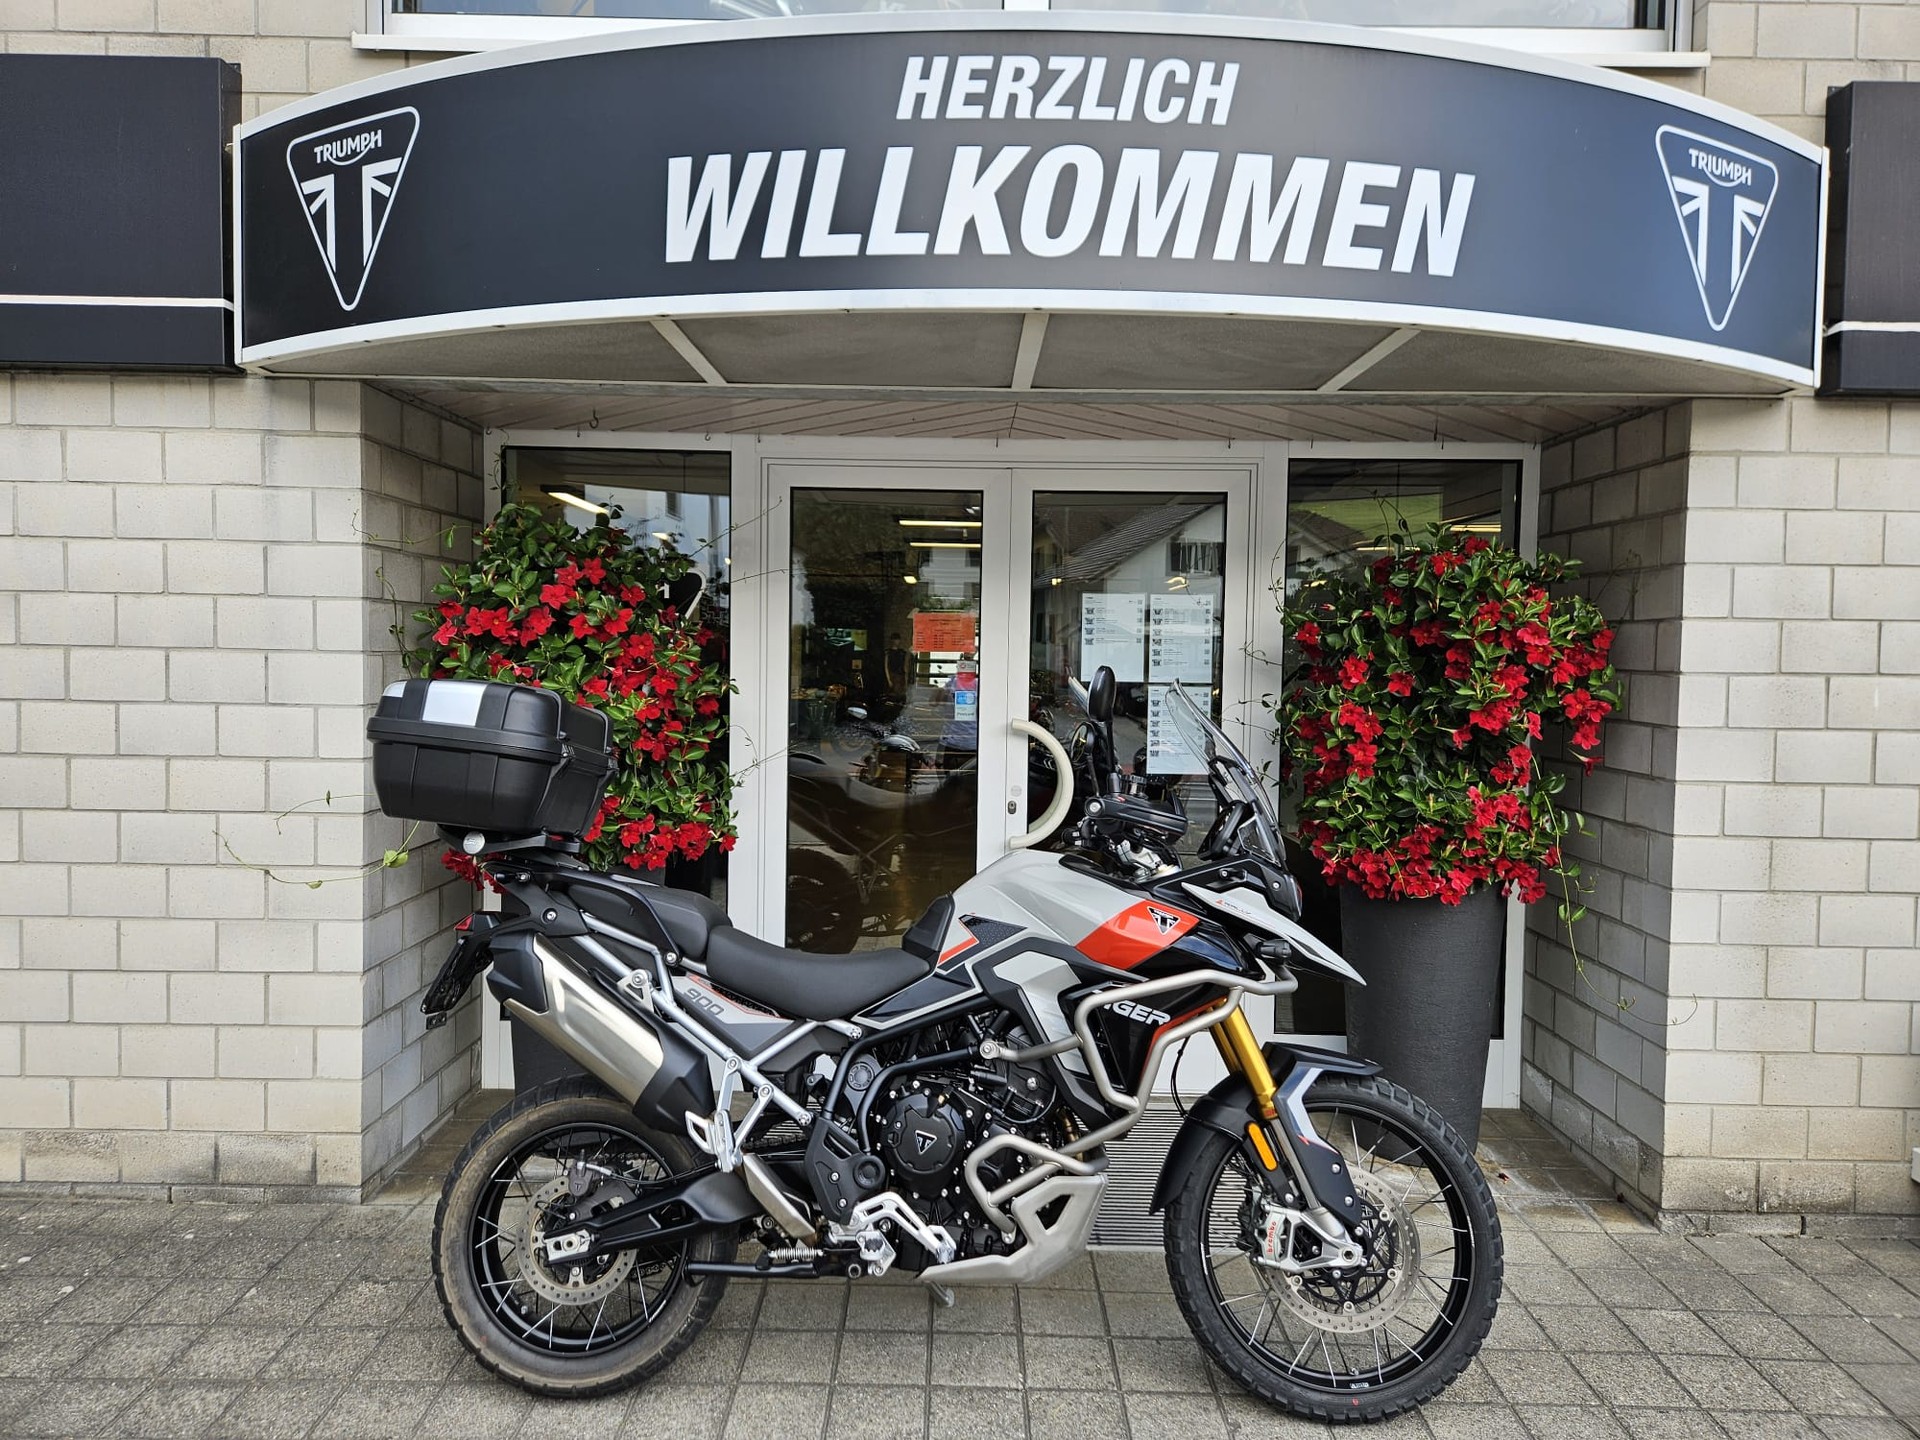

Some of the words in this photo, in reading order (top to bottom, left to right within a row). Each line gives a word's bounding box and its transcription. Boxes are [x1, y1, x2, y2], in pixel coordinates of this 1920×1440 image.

[896, 55, 1240, 126] HERZLICH
[314, 129, 382, 165] TRIUMPH
[1688, 148, 1752, 187] TRIUMPH
[664, 144, 1477, 278] WILLKOMMEN
[687, 988, 724, 1015] 900
